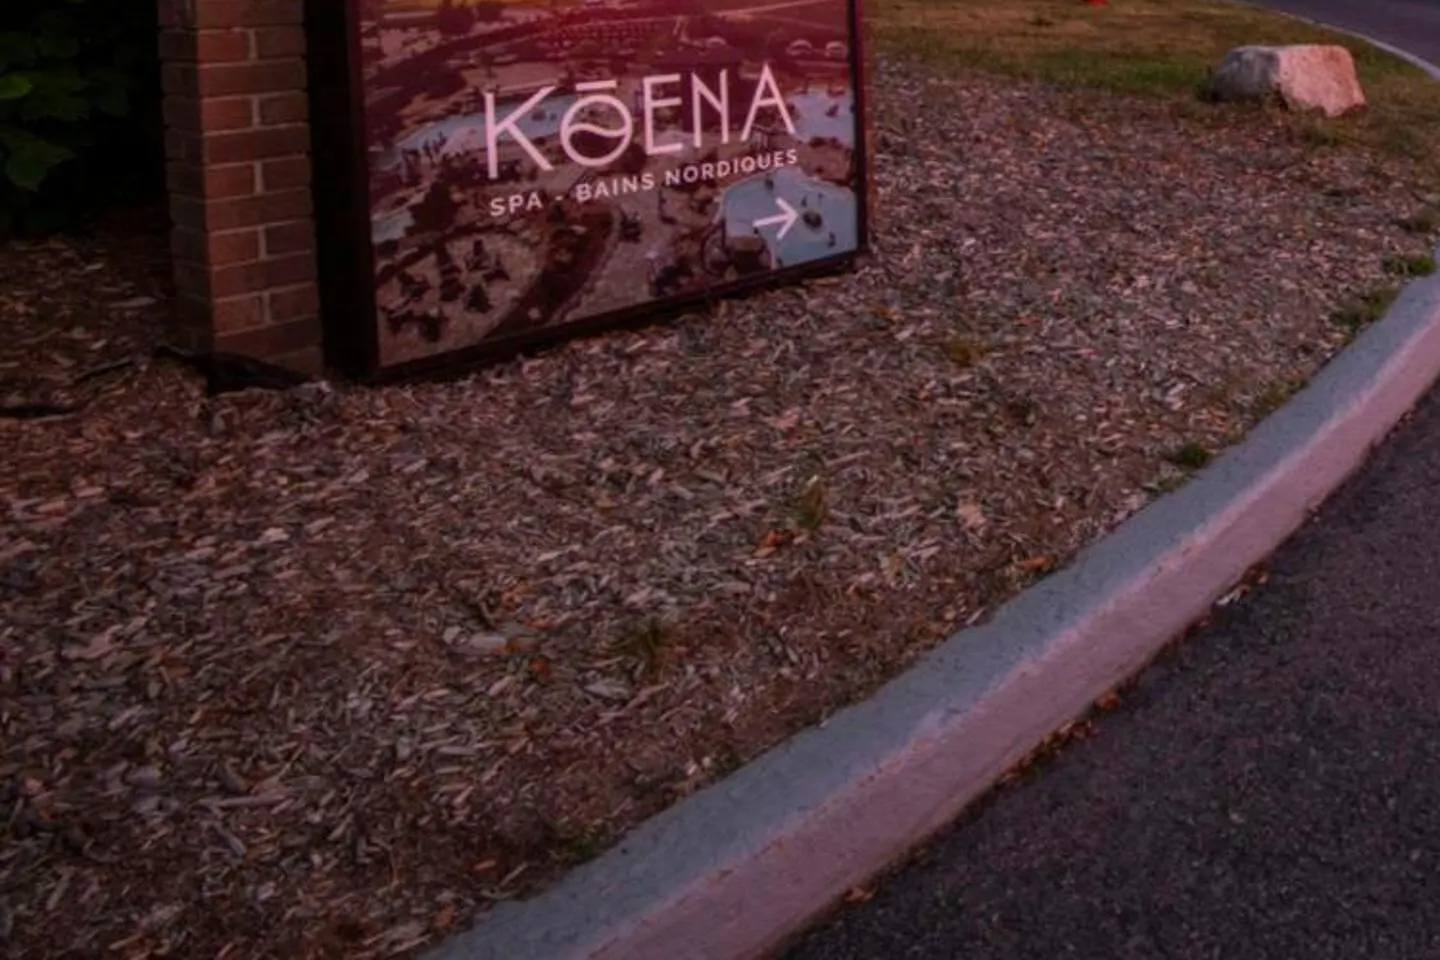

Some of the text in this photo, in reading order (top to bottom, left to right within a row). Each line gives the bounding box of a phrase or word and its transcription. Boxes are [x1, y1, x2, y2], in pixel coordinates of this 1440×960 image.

[489, 192, 543, 218] SPA
[576, 172, 655, 203] BAINS
[665, 148, 799, 187] NORDIQUES
